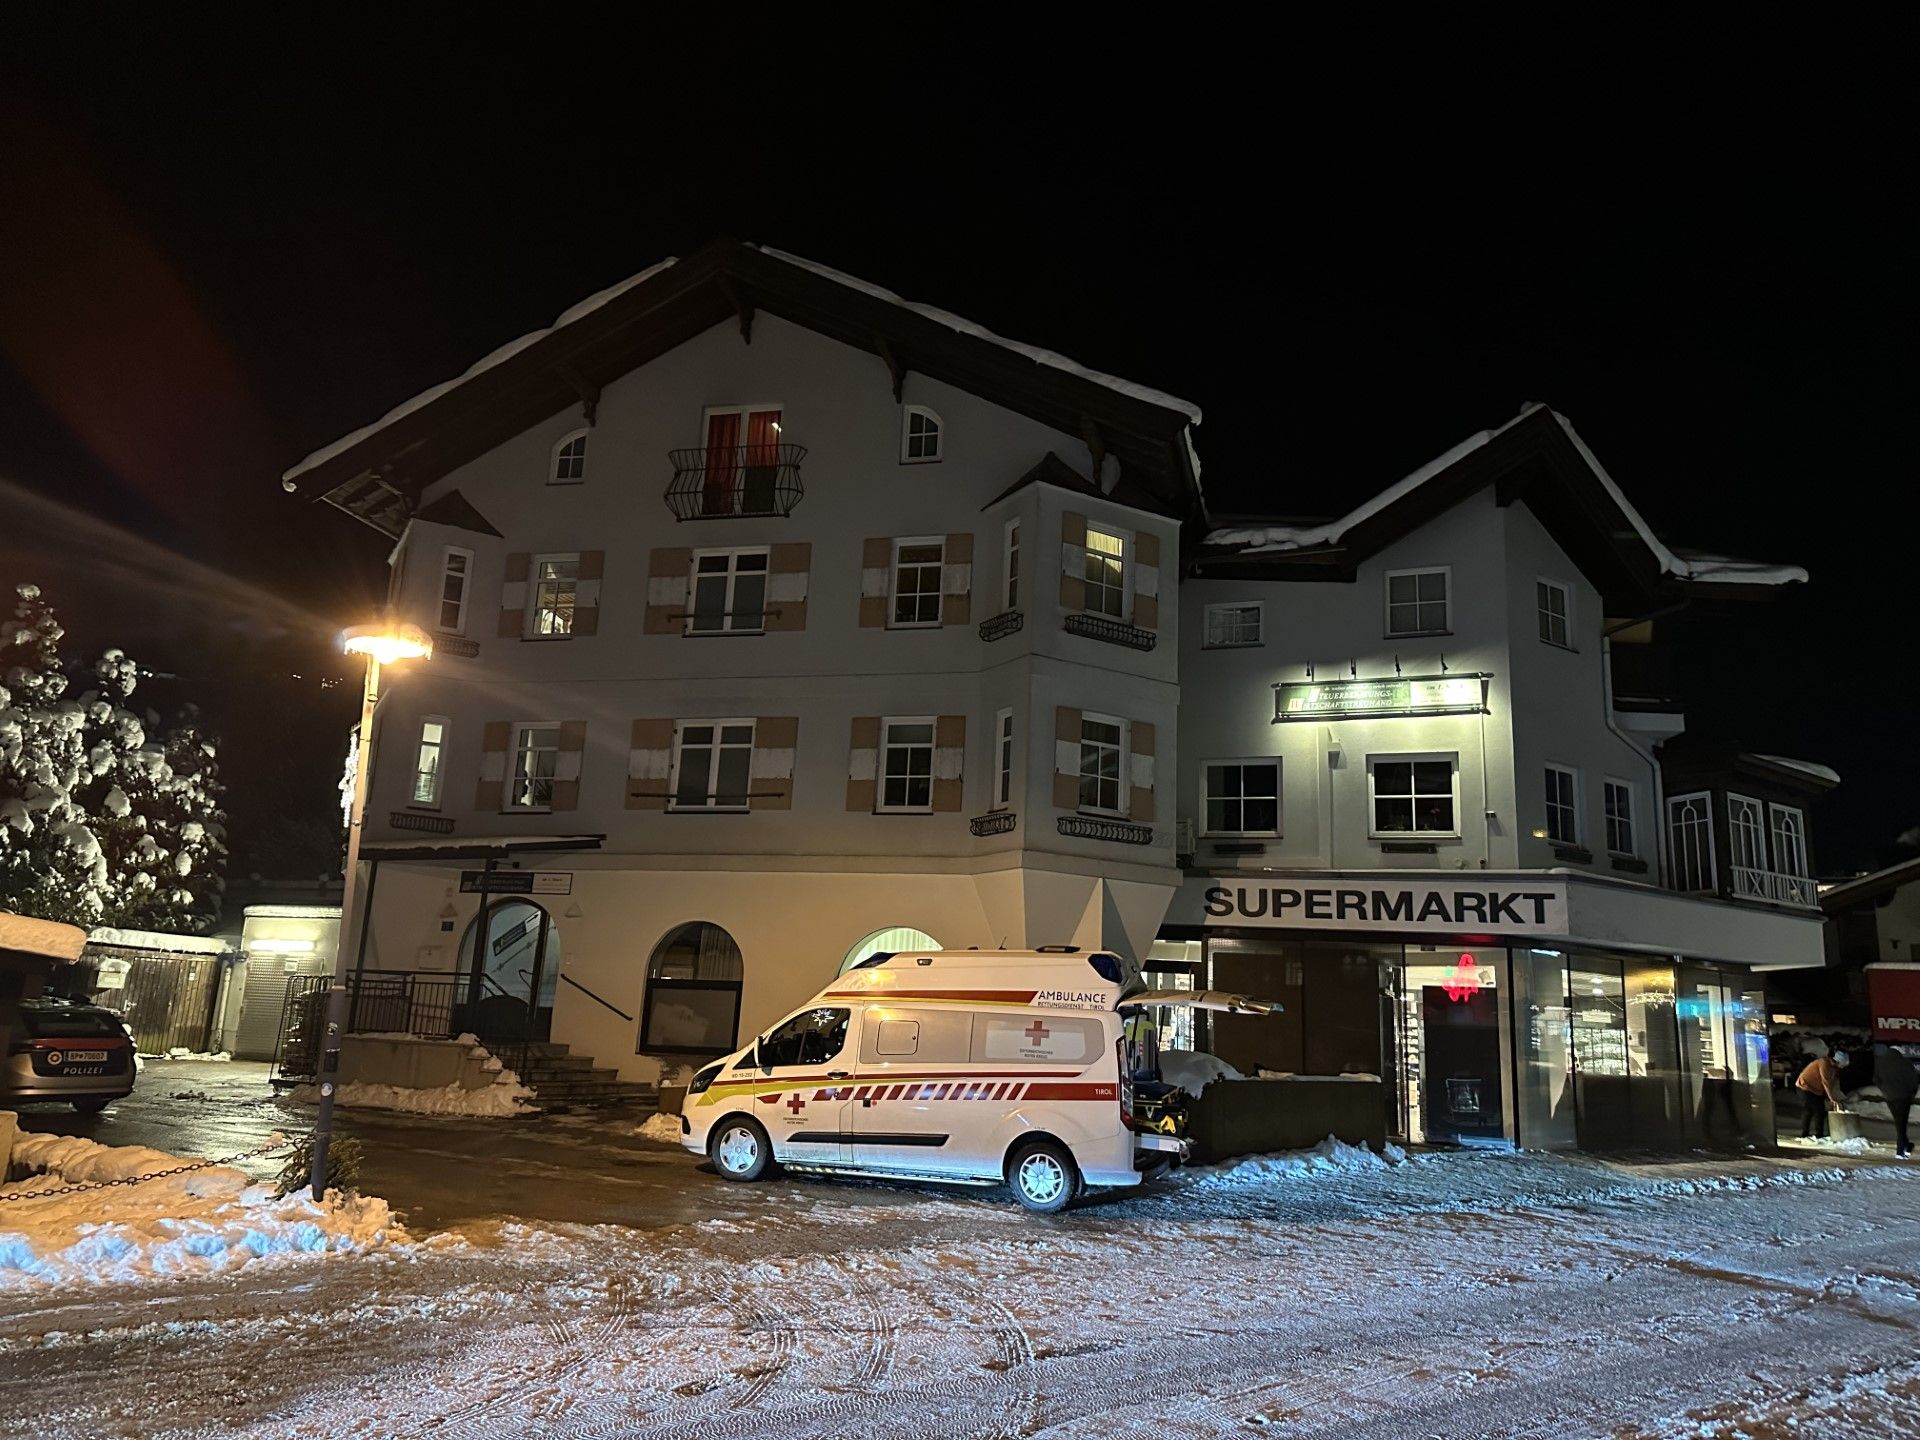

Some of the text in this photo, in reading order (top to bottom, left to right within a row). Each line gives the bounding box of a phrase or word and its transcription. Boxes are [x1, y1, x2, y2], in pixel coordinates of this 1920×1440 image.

[1204, 887, 1556, 925] SUPERMARKT
[1038, 990, 1106, 1004] AMBULANCE
[63, 1067, 103, 1075] POLIZEI
[1094, 1088, 1113, 1096] TIROL
